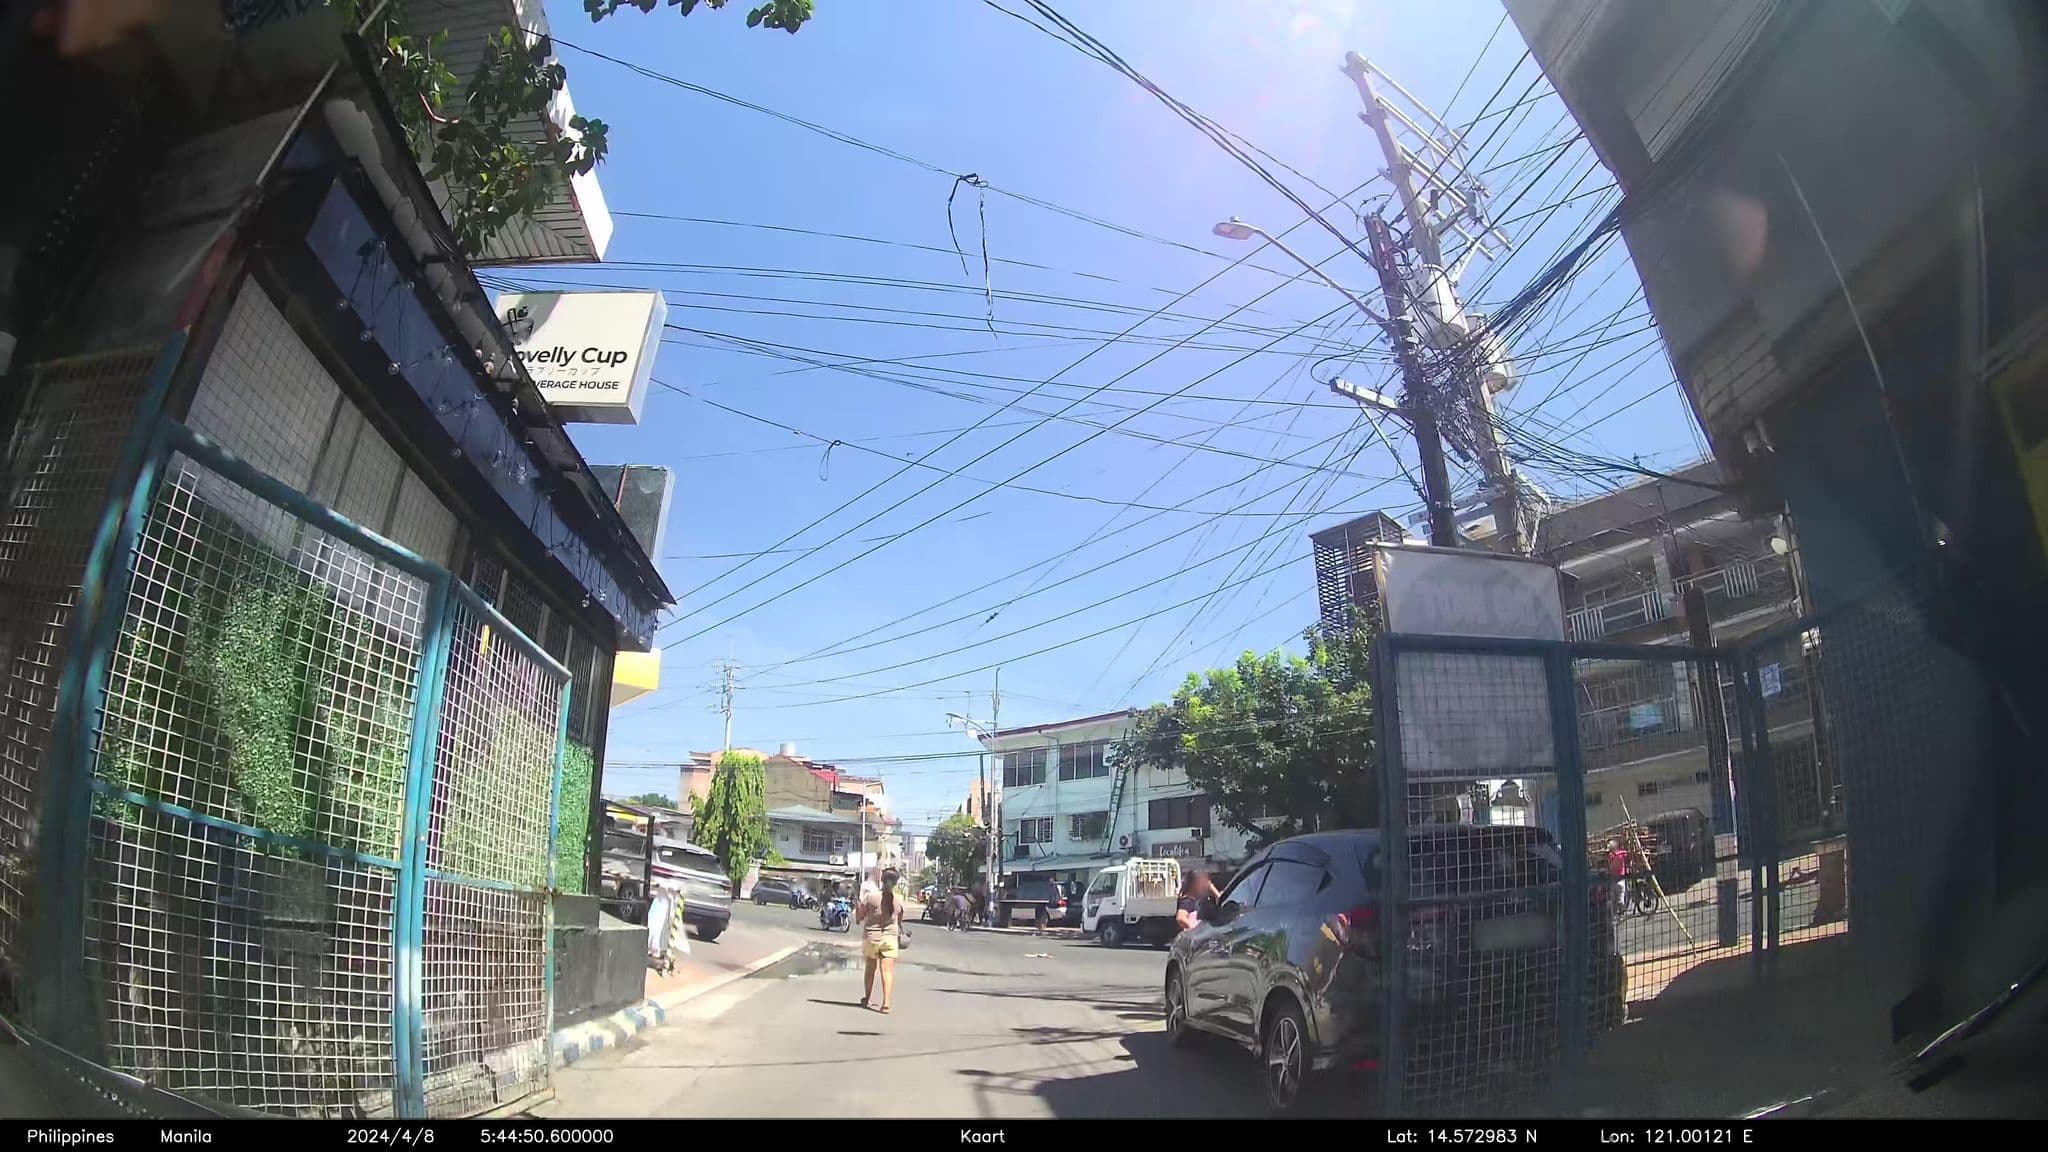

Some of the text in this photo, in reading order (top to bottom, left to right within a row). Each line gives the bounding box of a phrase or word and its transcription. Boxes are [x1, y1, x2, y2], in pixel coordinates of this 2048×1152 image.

[516, 346, 628, 368] ovelly Cup
[533, 380, 620, 390] VERAGE HOUSE
